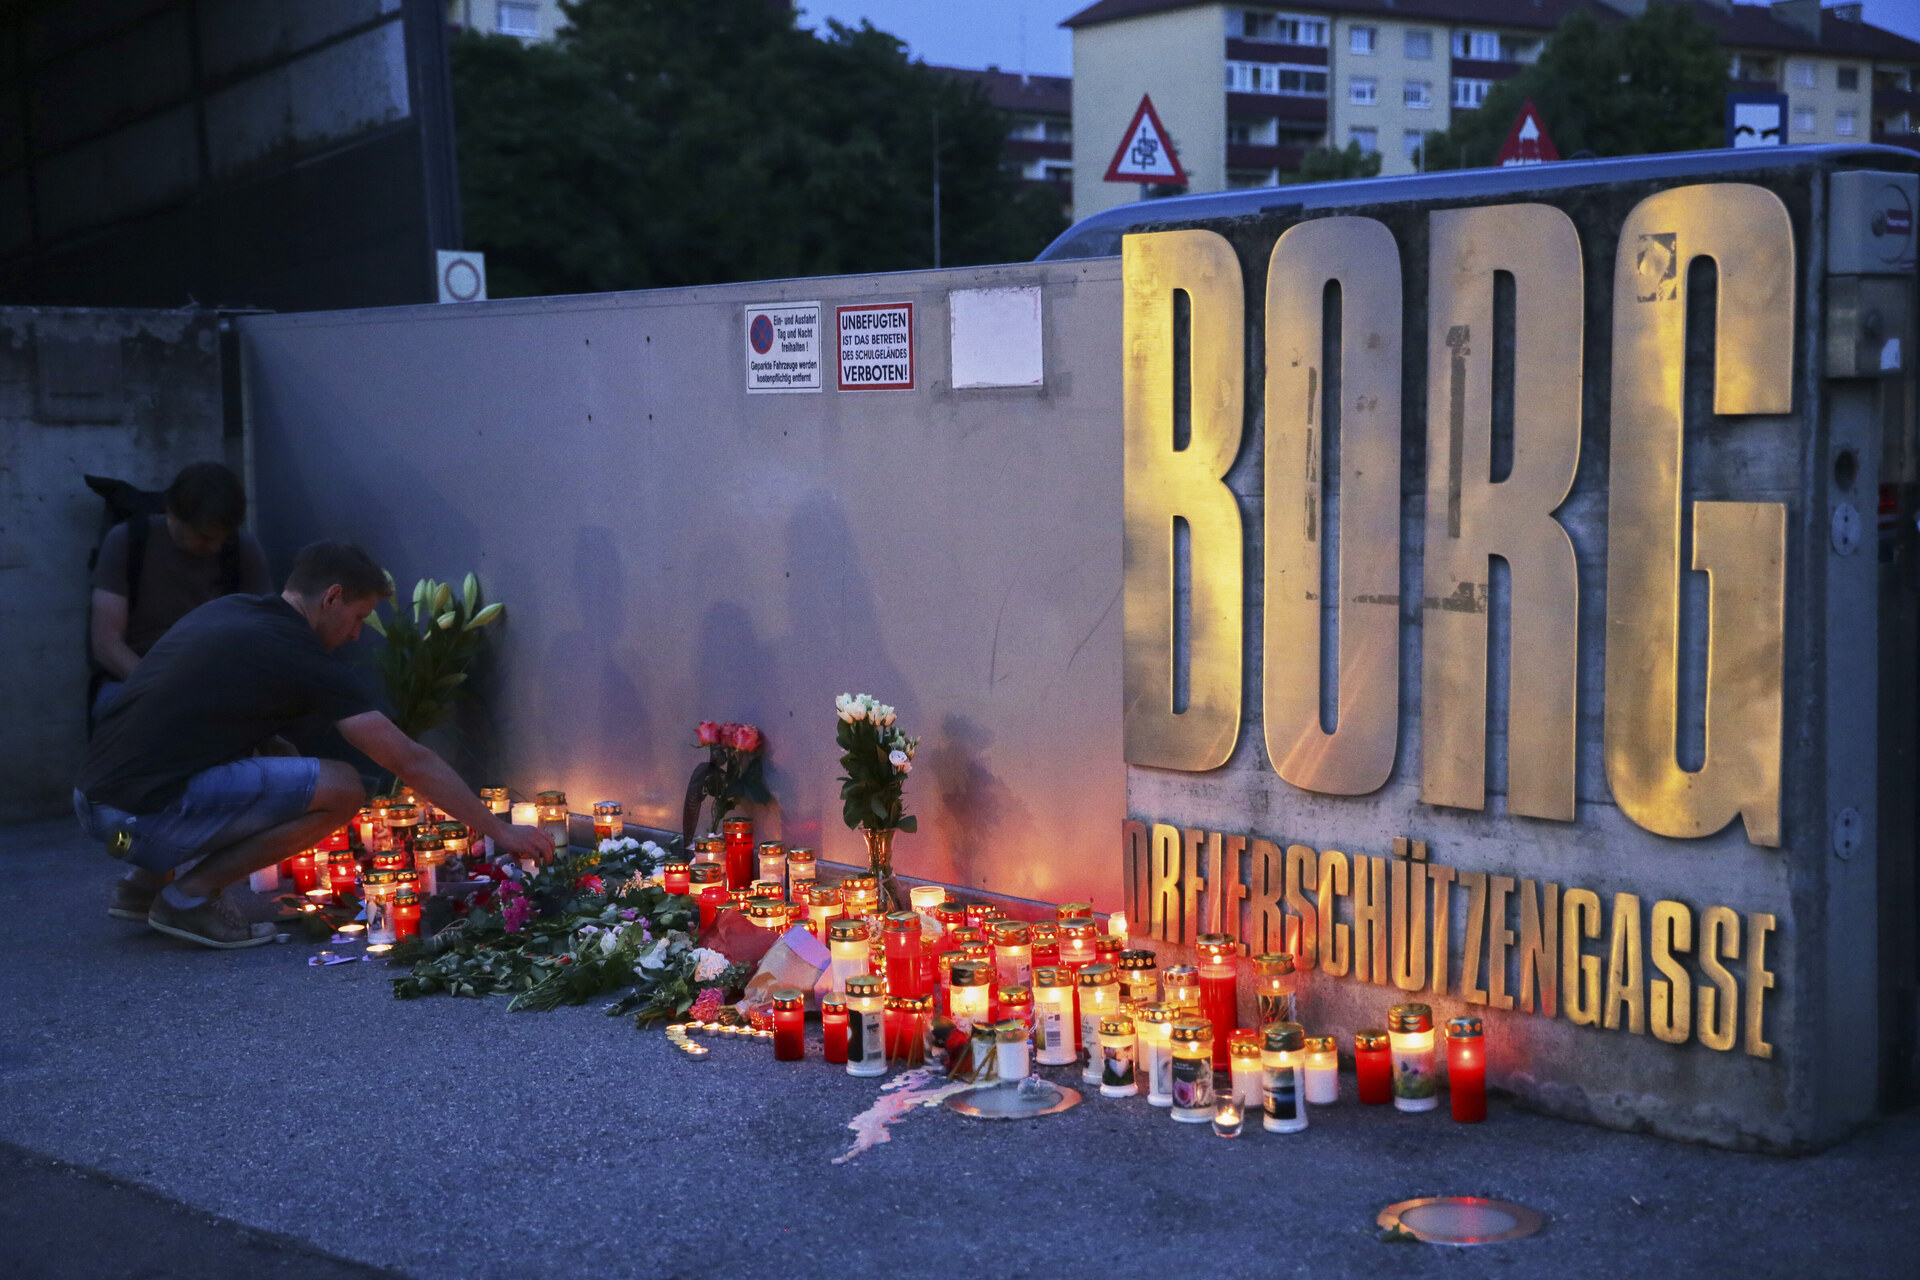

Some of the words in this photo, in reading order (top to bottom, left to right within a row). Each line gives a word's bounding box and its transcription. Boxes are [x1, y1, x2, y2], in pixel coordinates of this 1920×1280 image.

[773, 315, 784, 326] Ein-
[784, 314, 794, 325] und
[794, 314, 817, 325] Ausfahrt
[842, 312, 906, 330] UNBEFUGTEN
[777, 328, 786, 341] Tag
[787, 328, 797, 339] und
[797, 328, 813, 338] Nacht
[842, 335, 852, 346] IST
[854, 334, 870, 346] DAS
[871, 333, 907, 345] BETRETEN
[781, 342, 806, 353] freihalten
[842, 350, 854, 361] DES
[855, 346, 908, 360] SCHULGELÄNDES
[750, 361, 772, 372] Geparkte
[773, 360, 798, 372] Fahrzeuge
[799, 360, 818, 369] werden
[756, 373, 791, 385] kostenpflichtig
[792, 373, 811, 382] entfernt
[843, 364, 908, 382] VERBOTEN!
[1121, 182, 1796, 846] BORG
[1121, 820, 1777, 1058] DREIERSCHÜTZENGASSE
